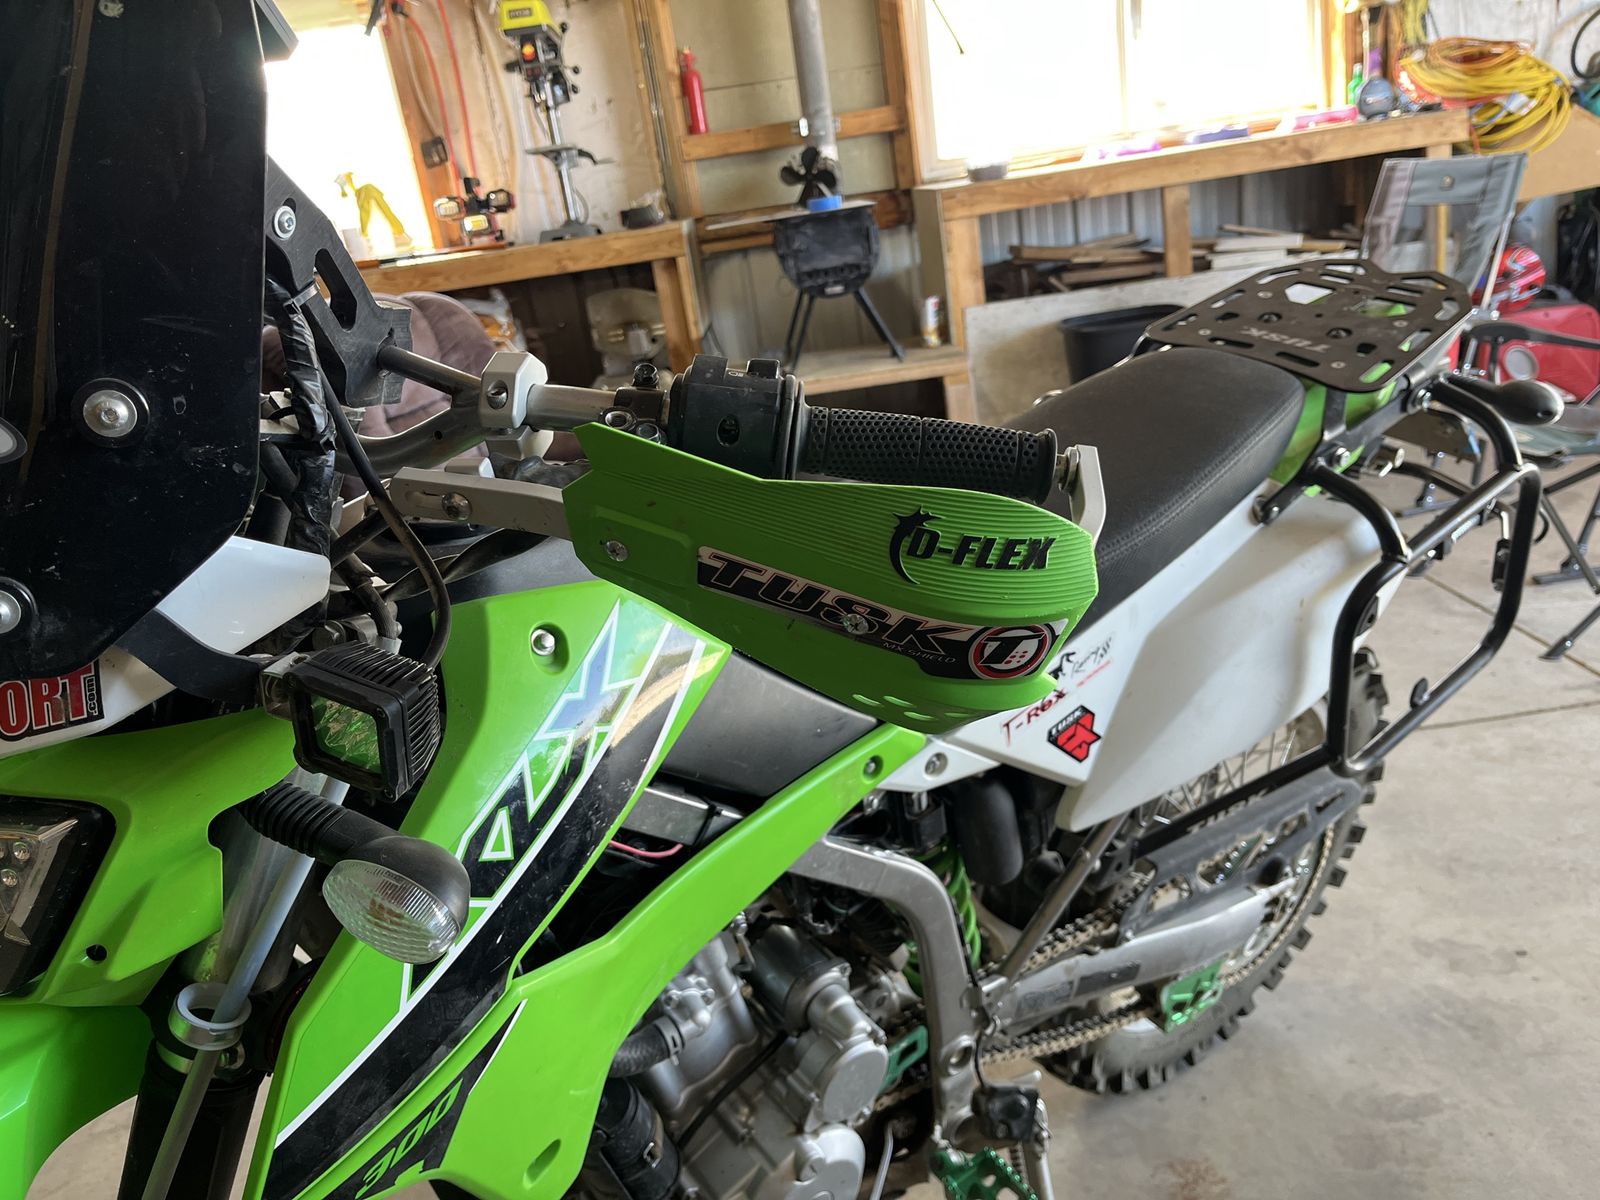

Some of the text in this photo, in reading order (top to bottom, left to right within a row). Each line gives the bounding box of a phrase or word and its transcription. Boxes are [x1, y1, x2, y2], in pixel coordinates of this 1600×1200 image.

[907, 526, 1058, 571] D-FLEX
[708, 551, 972, 656] TUSK
[883, 641, 957, 664] MX SHIELD
[354, 1077, 464, 1200] 300
